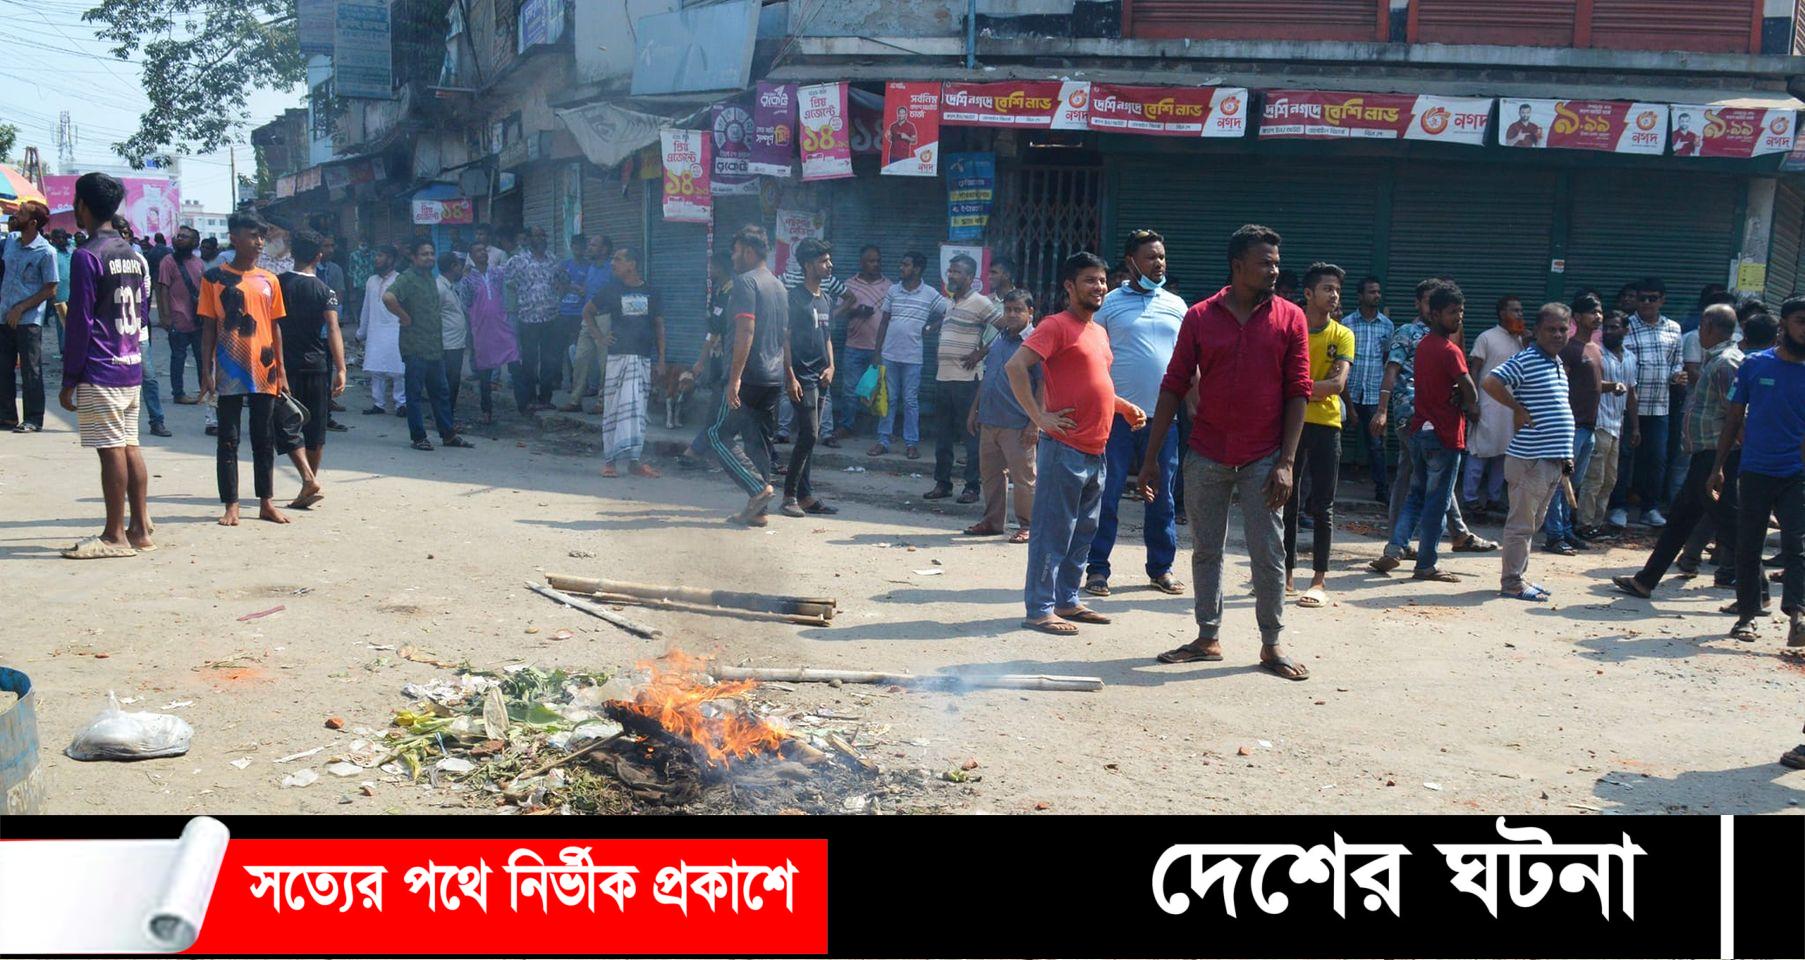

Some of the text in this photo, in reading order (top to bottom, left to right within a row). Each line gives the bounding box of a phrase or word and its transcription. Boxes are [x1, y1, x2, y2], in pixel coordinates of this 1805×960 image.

[945, 91, 968, 107] দেশি
[994, 91, 1024, 113] বেশি
[1025, 97, 1052, 110] লাভ
[1093, 95, 1116, 112] দেশি
[1143, 97, 1175, 120] বেশি
[1175, 104, 1202, 117] লাভ
[1289, 103, 1321, 120] নগদে
[1323, 98, 1364, 126] বেশি
[1364, 106, 1400, 122] লাভ
[1217, 116, 1242, 129] নগদ
[1454, 113, 1488, 129] নগদ
[1632, 132, 1658, 145] নগদ
[1766, 136, 1791, 148] নগদ
